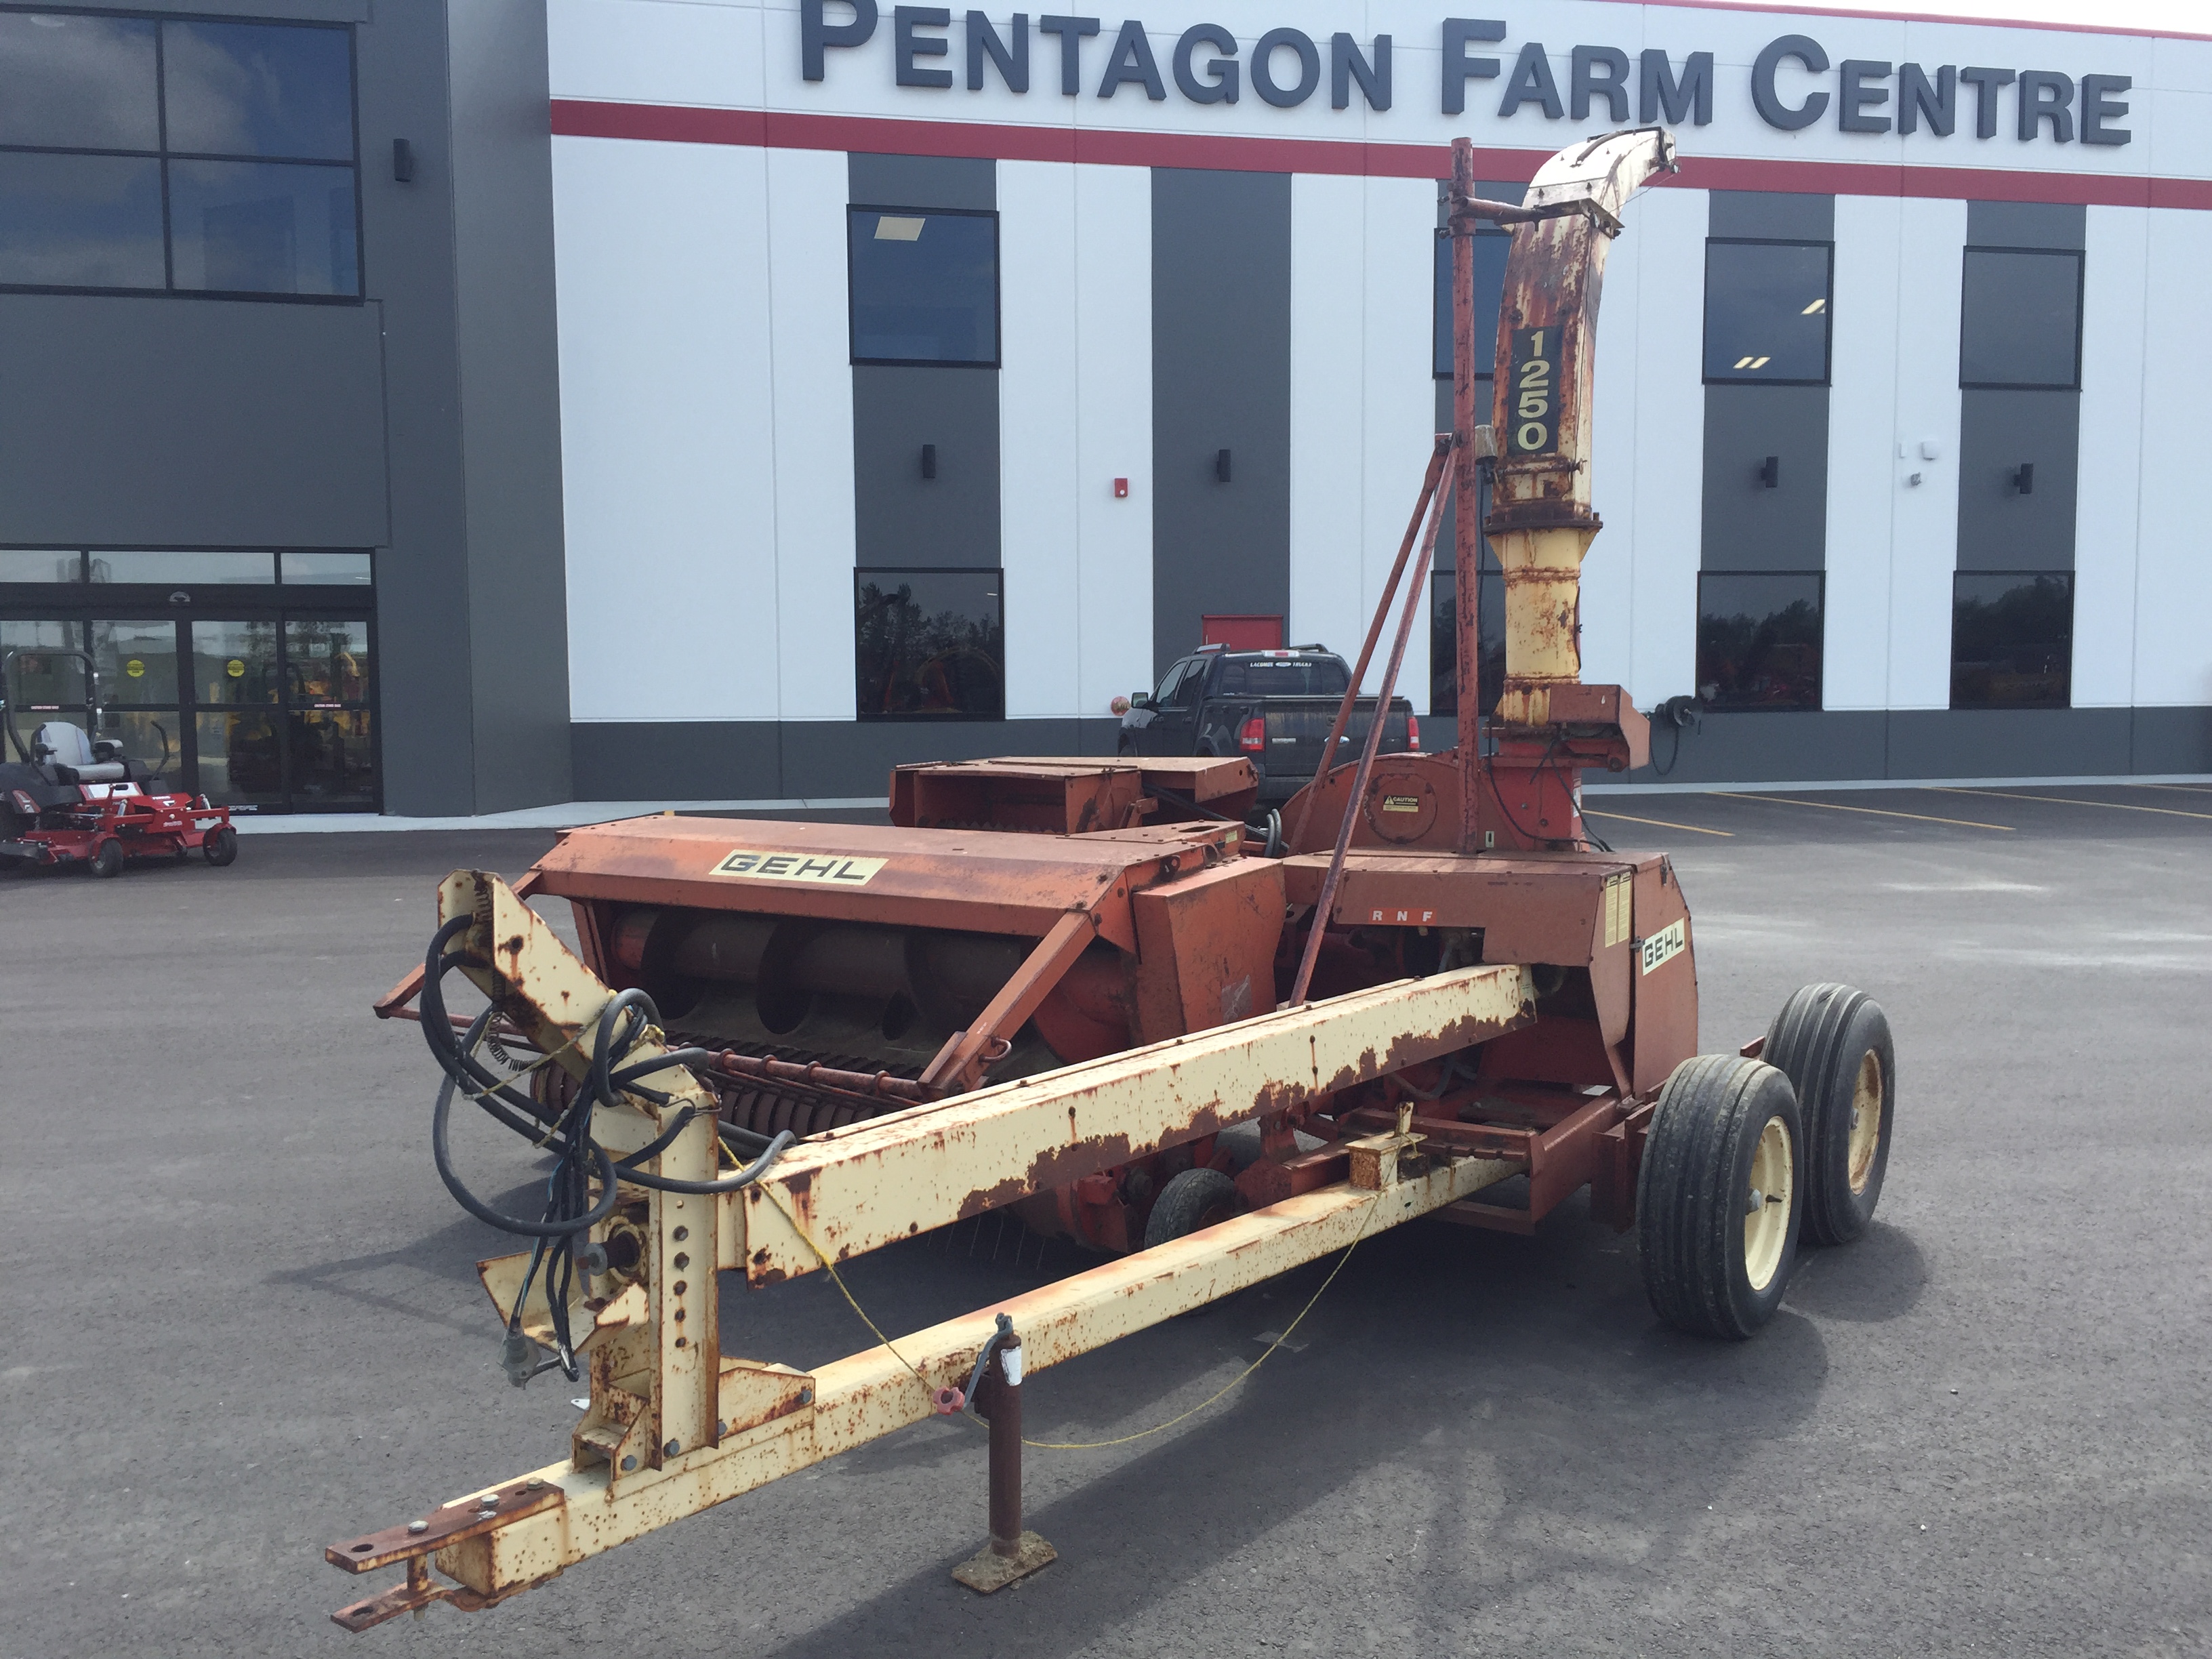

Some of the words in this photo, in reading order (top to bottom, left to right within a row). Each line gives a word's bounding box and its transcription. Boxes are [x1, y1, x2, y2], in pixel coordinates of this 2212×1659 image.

[801, 0, 1393, 111] PENTAGON
[1441, 18, 1714, 126] FARM
[1750, 34, 2133, 145] CENTRE
[1517, 330, 1550, 451] 1250
[720, 853, 867, 880] GEHL
[1644, 927, 1684, 968] GEHL
